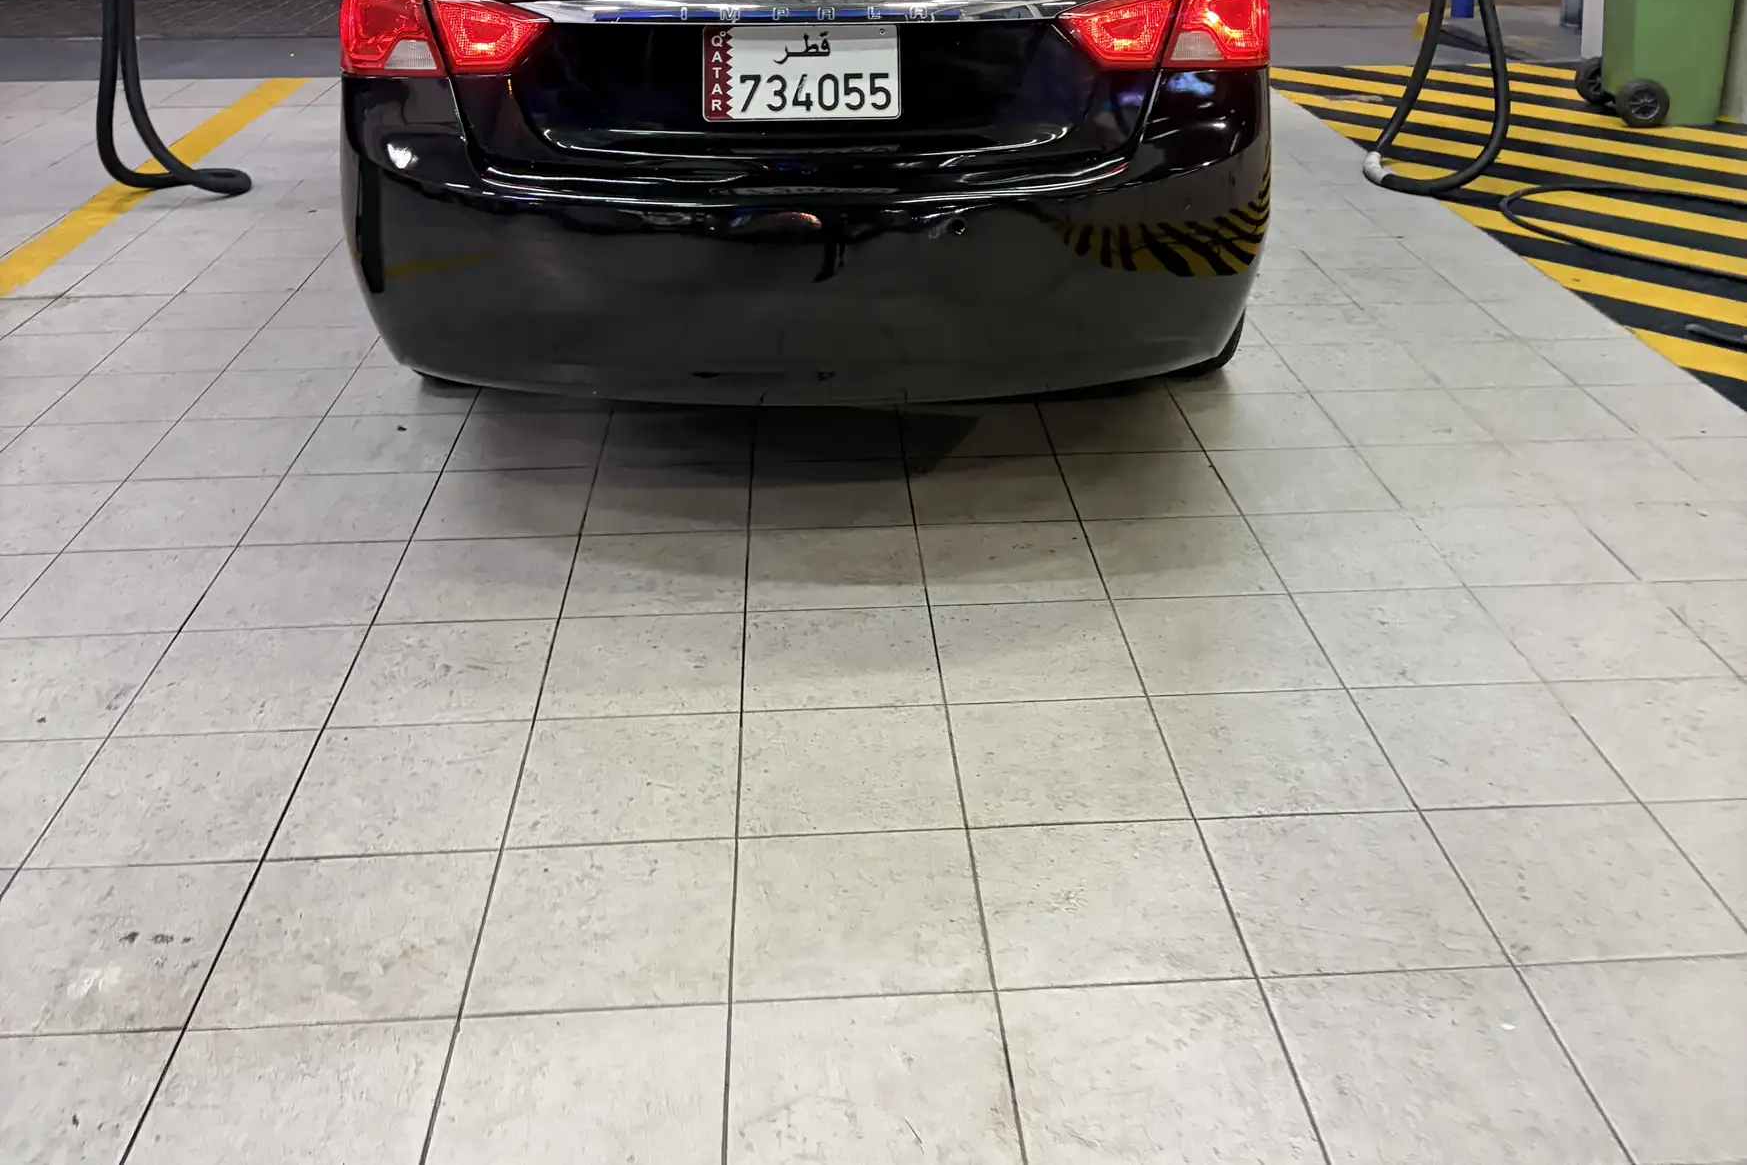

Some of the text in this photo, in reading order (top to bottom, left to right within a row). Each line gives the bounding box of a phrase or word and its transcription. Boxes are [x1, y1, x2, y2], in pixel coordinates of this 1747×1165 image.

[679, 6, 928, 22] IMPALA
[773, 31, 831, 65] قطر
[710, 34, 724, 112] QATAR
[740, 73, 892, 113] 734055
